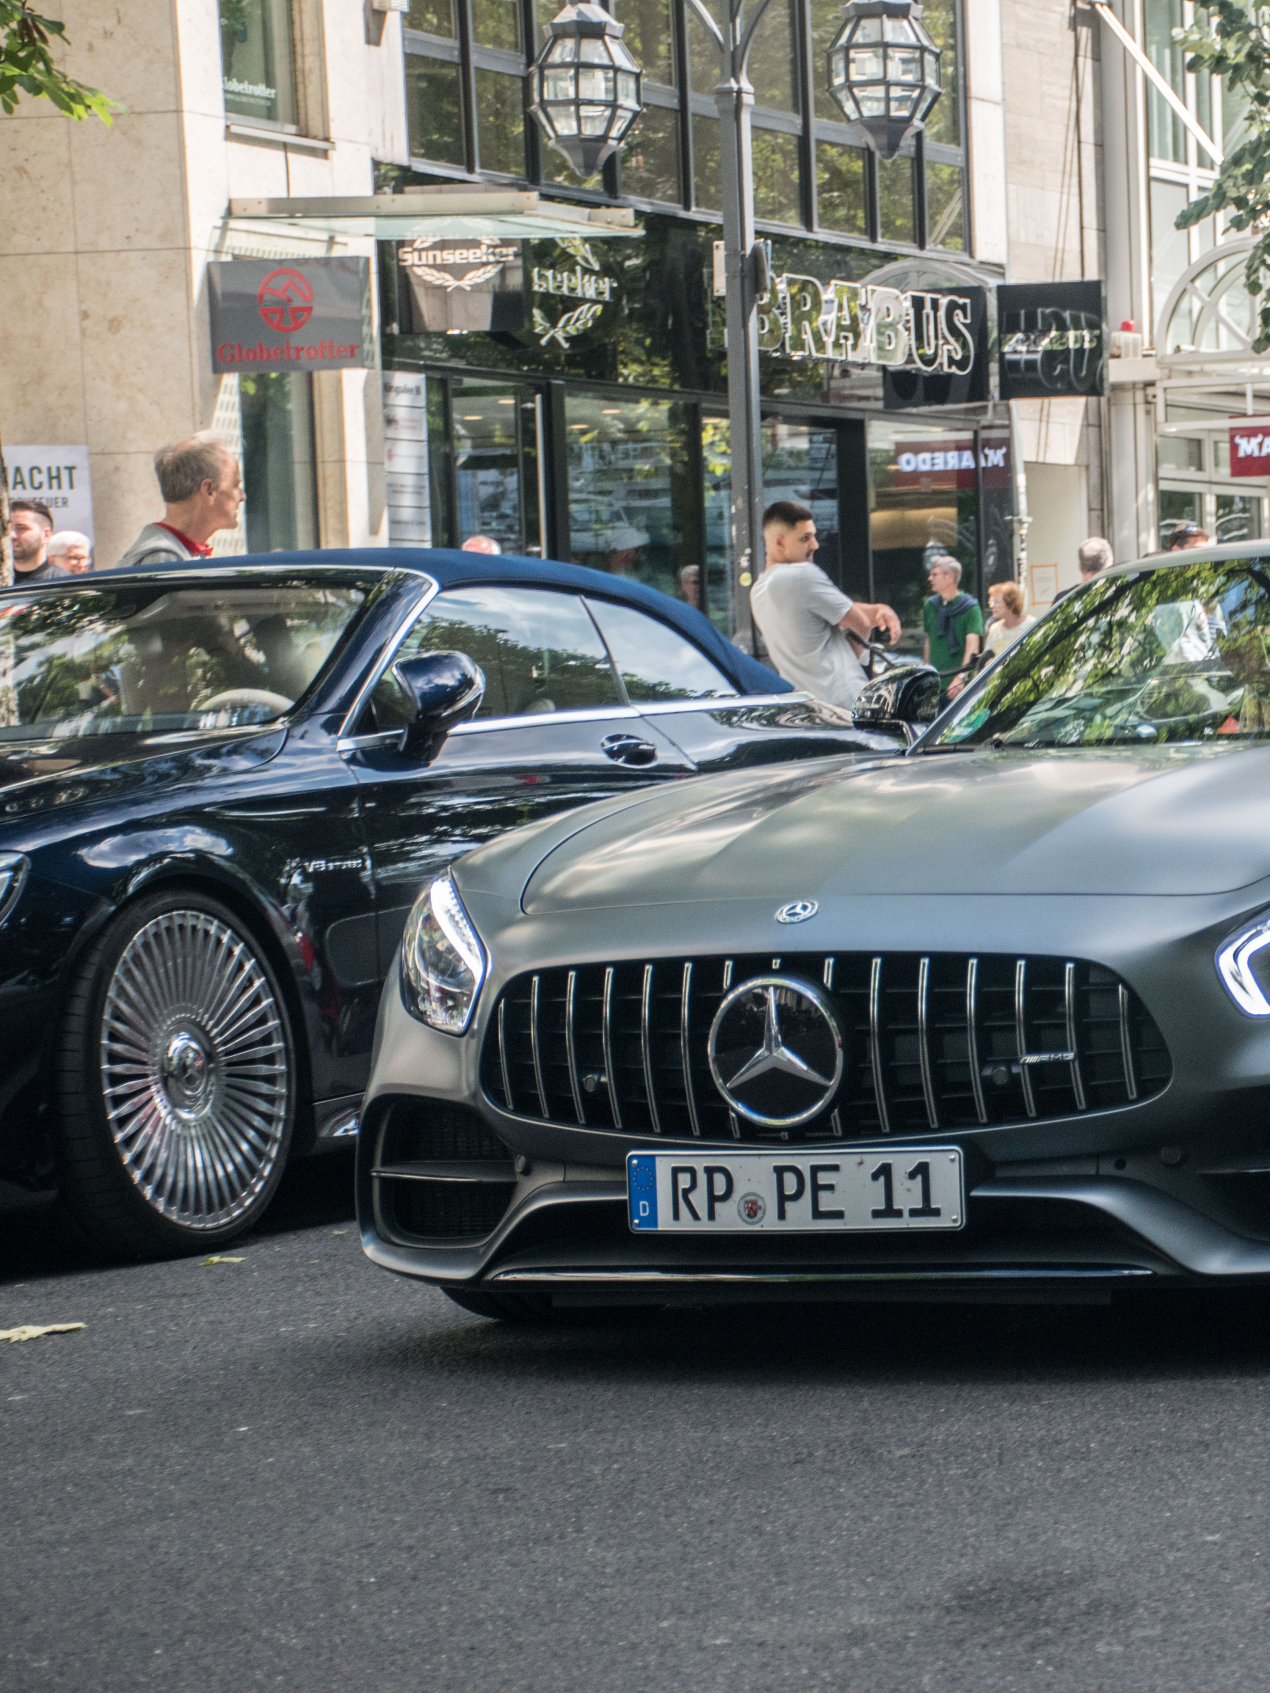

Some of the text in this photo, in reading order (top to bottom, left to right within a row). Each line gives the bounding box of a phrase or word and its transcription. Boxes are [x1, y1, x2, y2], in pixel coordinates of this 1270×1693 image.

[222, 76, 276, 99] lobetrotter
[398, 244, 518, 265] Sunseeker
[216, 339, 360, 363] Globetrotter
[5, 465, 78, 491] ACHT
[671, 1160, 941, 1221] RP PE 11
[639, 1201, 650, 1217] D
